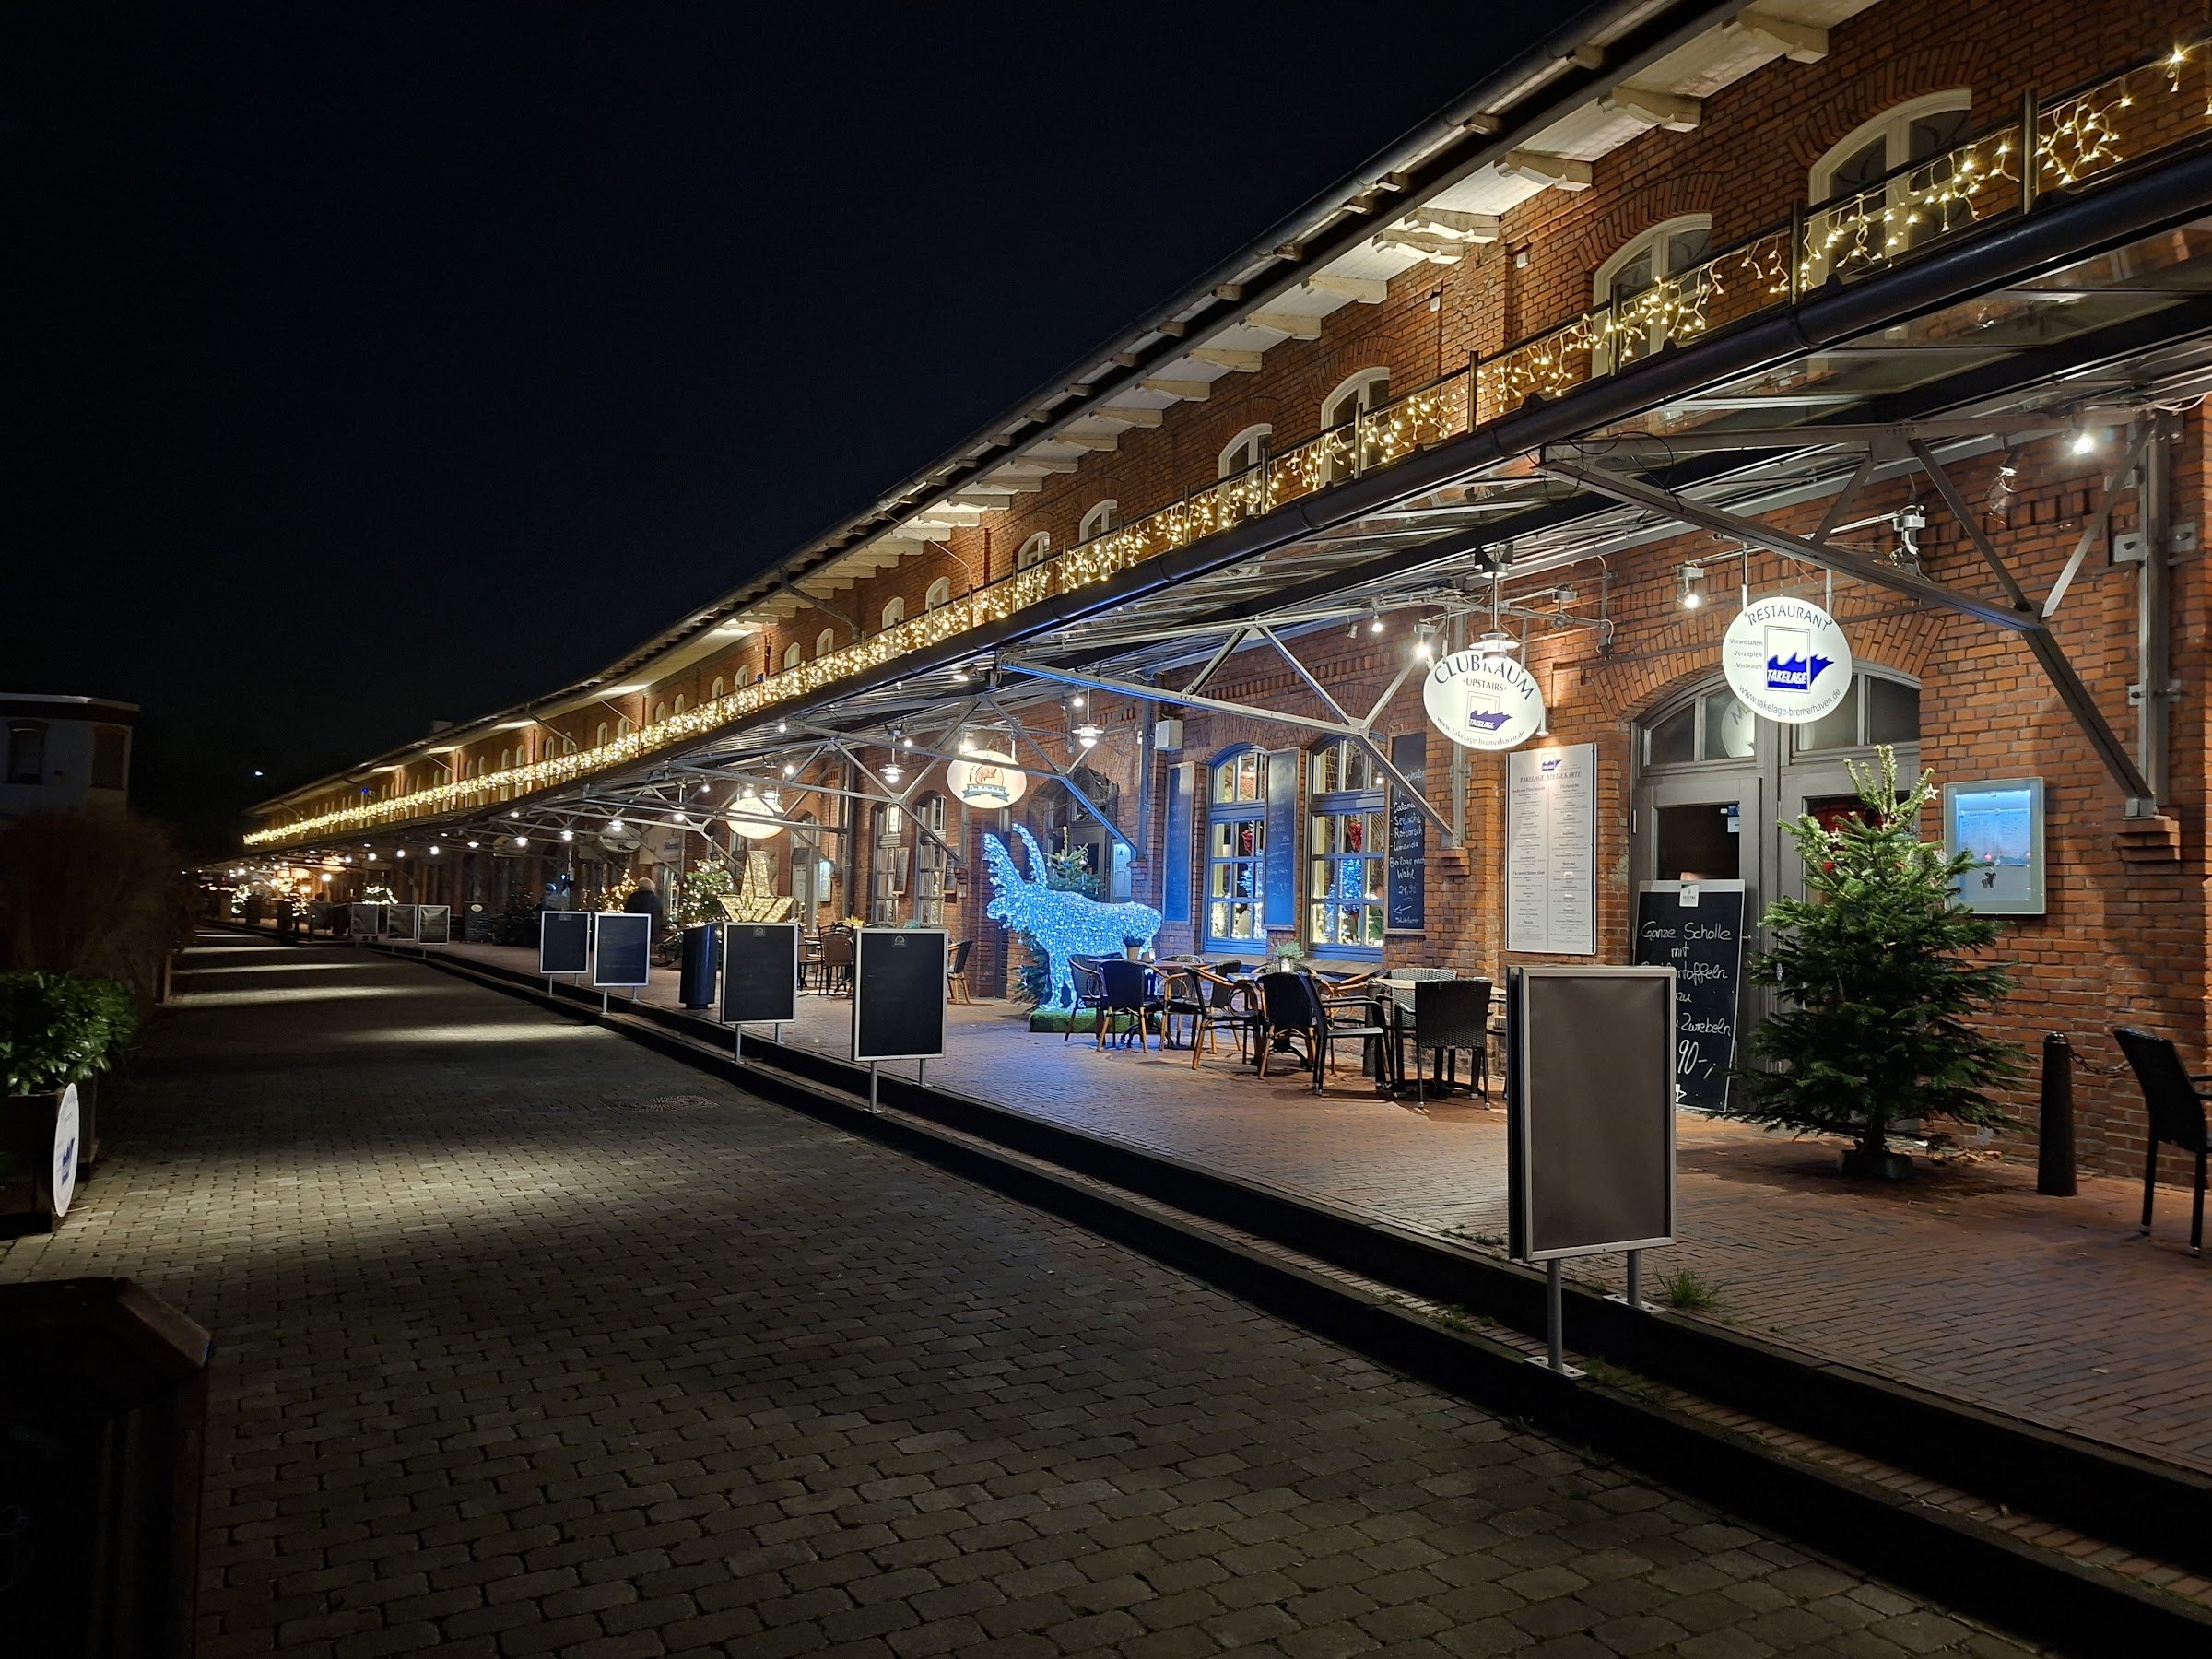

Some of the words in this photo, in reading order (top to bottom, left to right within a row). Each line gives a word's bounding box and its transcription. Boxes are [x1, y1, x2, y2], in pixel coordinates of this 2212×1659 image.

[1747, 605, 1830, 632] RESTAURANT
[1767, 669, 1808, 685] TAKELAGE
[1738, 684, 1841, 717] www.takelage-bremerhaven.de
[1641, 921, 1677, 939] Ganze
[1683, 921, 1732, 941] Scholle
[1670, 941, 1690, 959] mit
